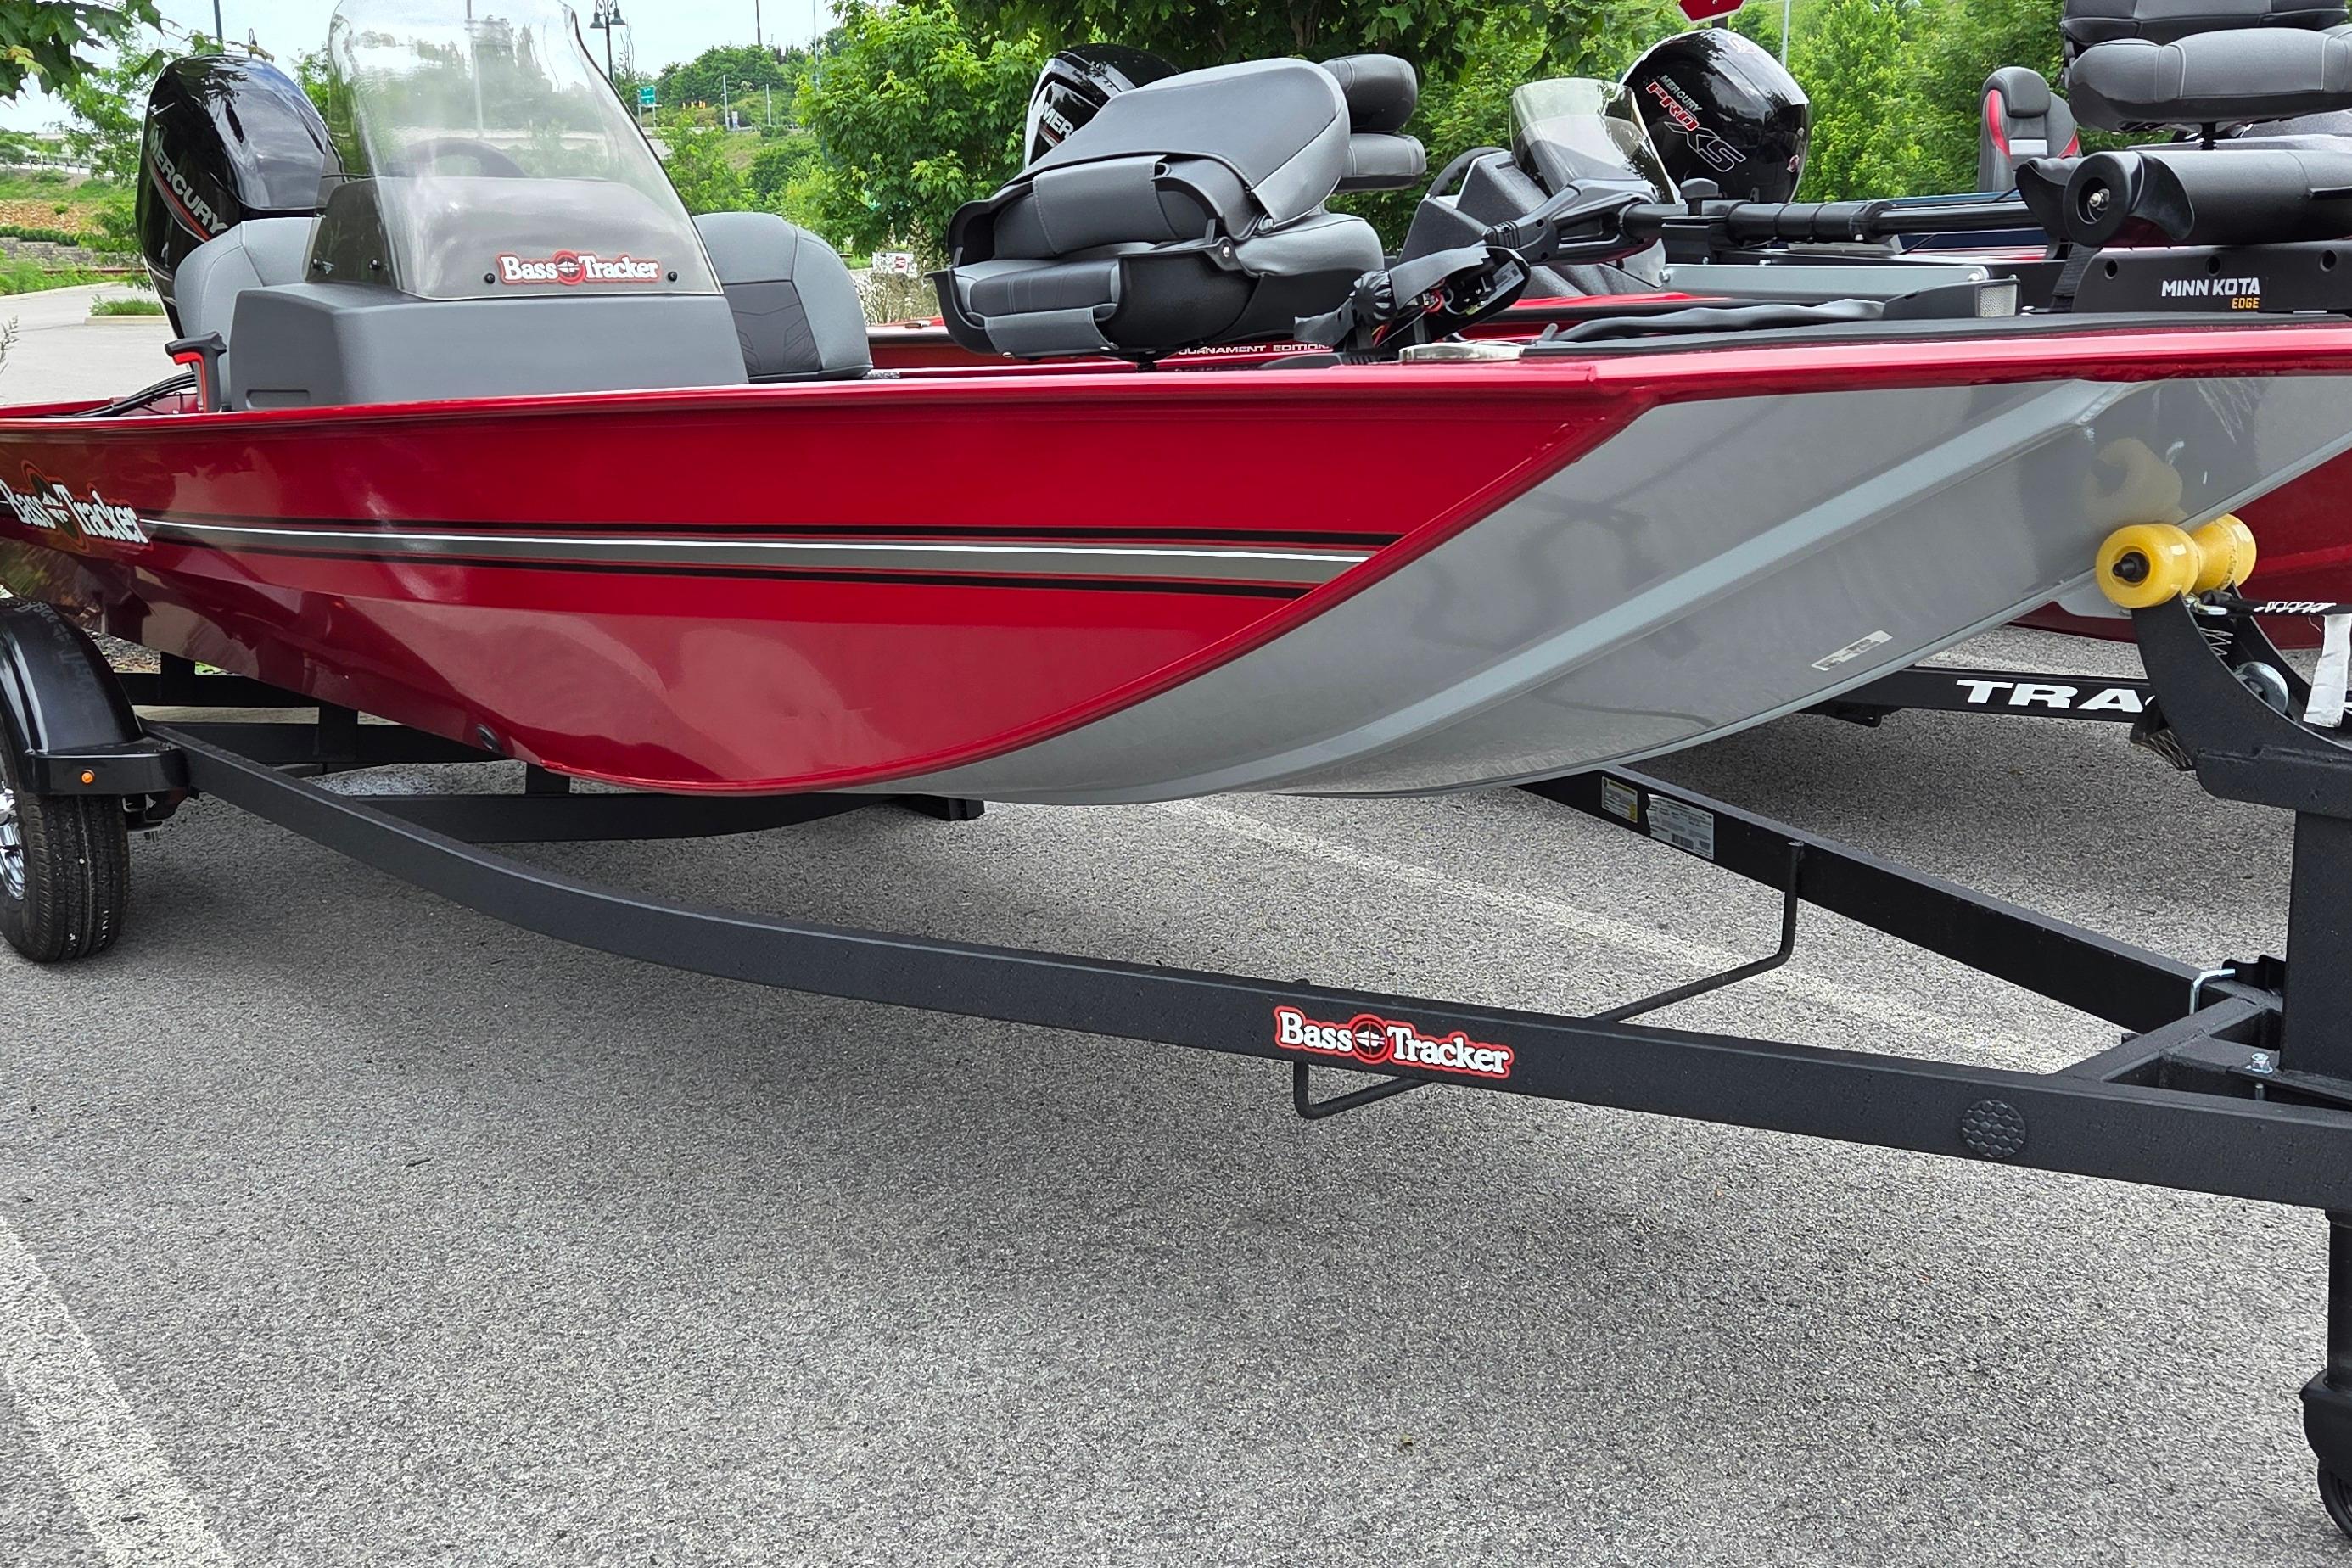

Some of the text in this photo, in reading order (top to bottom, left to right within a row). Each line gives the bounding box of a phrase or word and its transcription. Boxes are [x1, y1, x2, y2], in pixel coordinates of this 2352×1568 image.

[1646, 81, 1700, 132] PRO
[1660, 74, 1703, 112] MERCURY
[1664, 121, 1746, 172] XS
[148, 126, 229, 234] MERCURY
[500, 255, 658, 280] Bass Tracker
[2161, 277, 2260, 297] MINN KOTA
[2232, 297, 2260, 309] EDGE
[0, 479, 149, 543] Bass Tracker
[1957, 680, 2156, 714] TRA
[1280, 1011, 1509, 1073] Bass Tracker
